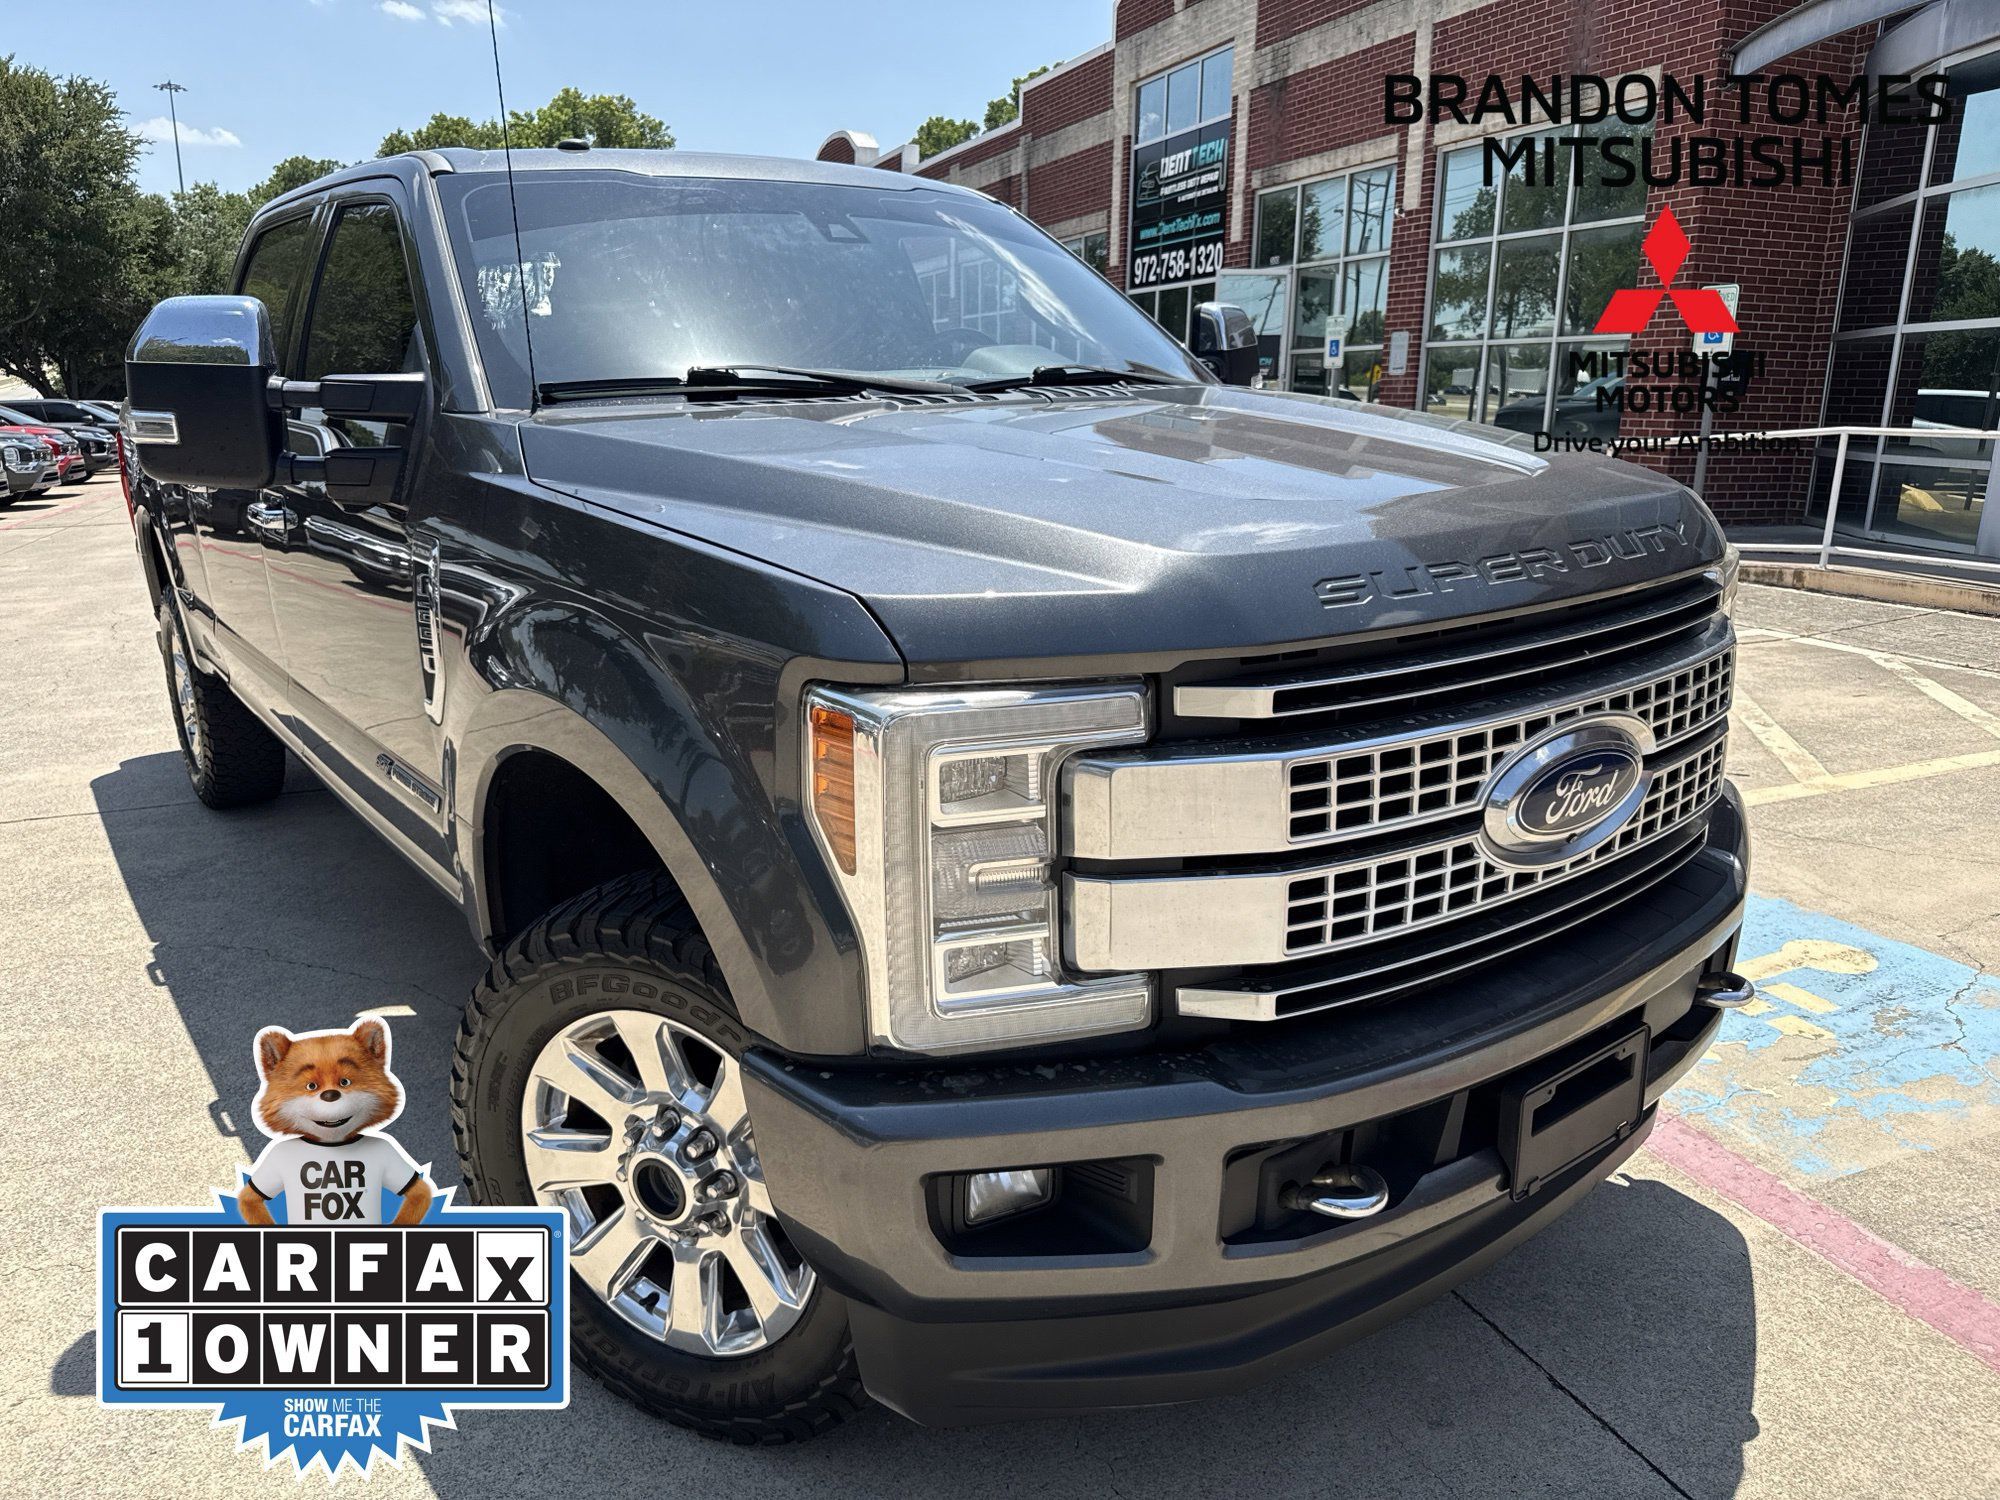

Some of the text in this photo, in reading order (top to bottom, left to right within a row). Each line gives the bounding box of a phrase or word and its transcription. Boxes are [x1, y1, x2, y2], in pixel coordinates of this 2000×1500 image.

[1134, 242, 1223, 285] 972-758-1320
[1312, 519, 1689, 610] SUPER DUTY
[1545, 763, 1619, 824] Ford
[549, 973, 742, 1043] BFGoodr
